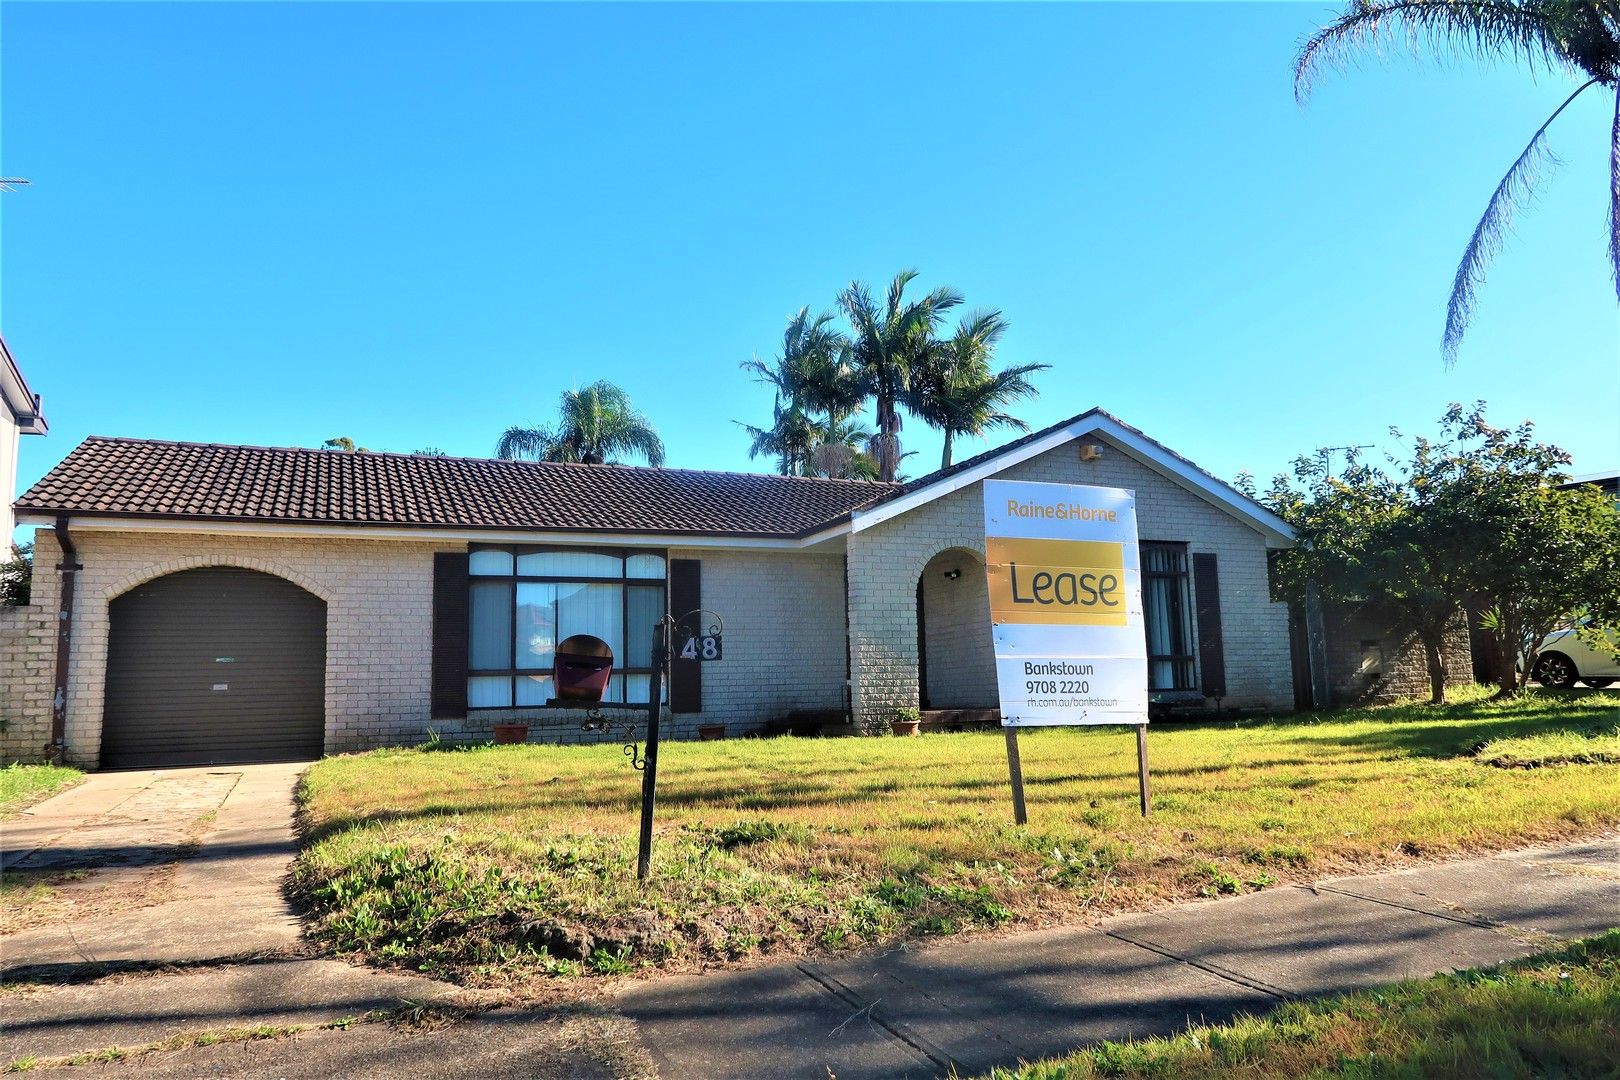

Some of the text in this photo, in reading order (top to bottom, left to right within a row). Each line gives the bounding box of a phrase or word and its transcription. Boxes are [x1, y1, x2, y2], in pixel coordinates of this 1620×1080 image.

[1007, 500, 1117, 523] Raine&Horne
[1010, 562, 1119, 607] Lease
[680, 637, 718, 660] 48
[1024, 662, 1094, 676] Bankstown
[1026, 681, 1090, 694] 9708 2220
[1027, 697, 1118, 708] rh.com.au/bankstown
